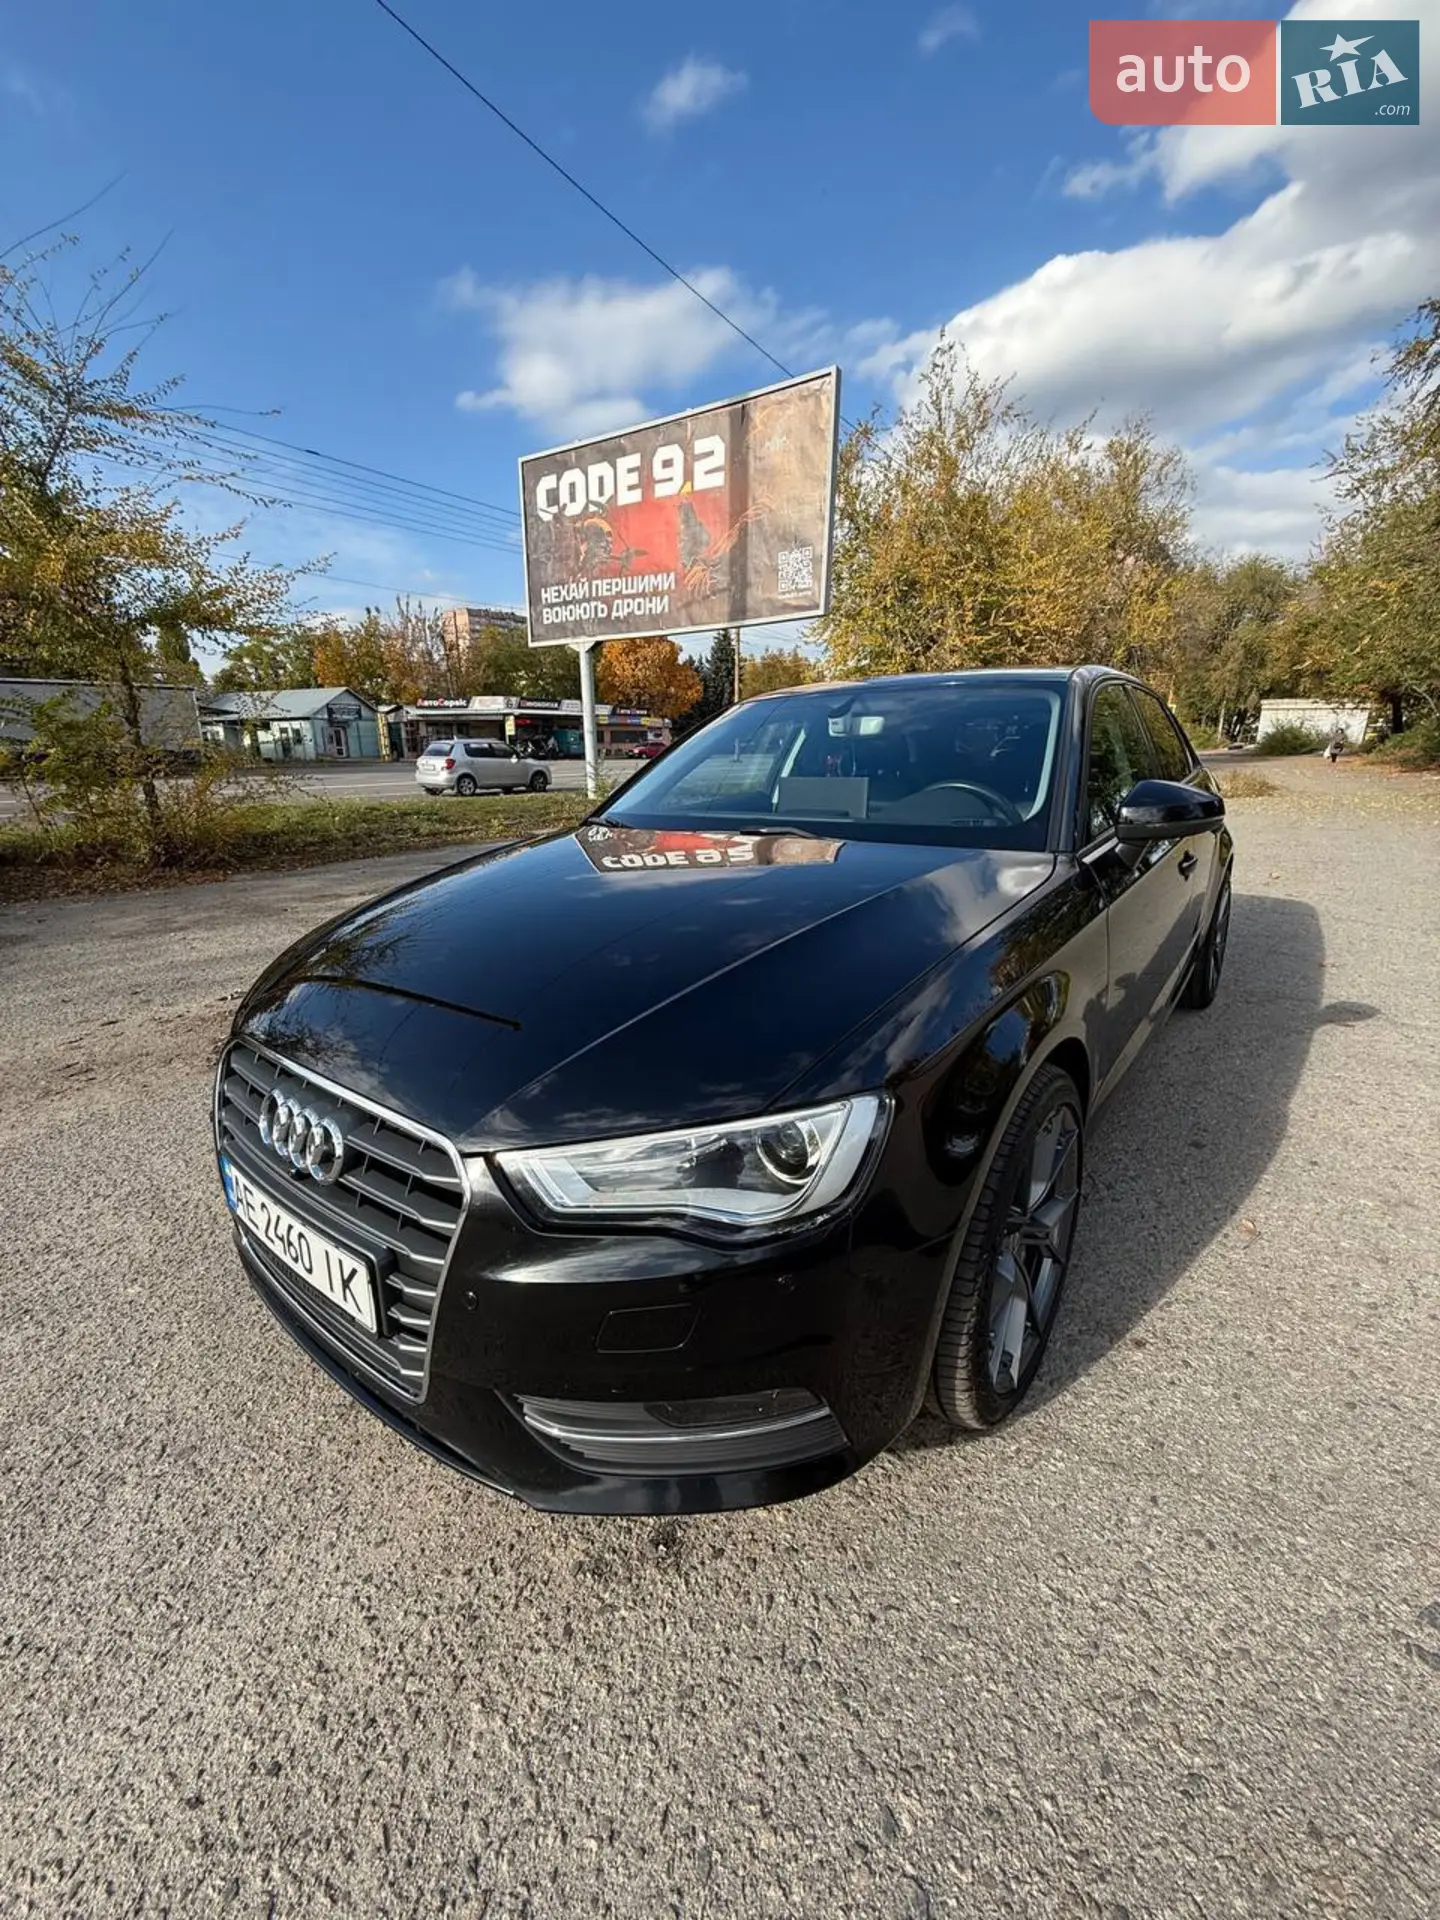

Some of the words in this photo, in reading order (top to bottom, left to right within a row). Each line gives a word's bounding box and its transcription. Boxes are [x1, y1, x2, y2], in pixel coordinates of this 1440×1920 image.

[536, 453, 642, 521] CODE
[541, 577, 589, 605] НЕХАЙ
[592, 572, 675, 597] ПЕРШИМИ
[611, 595, 669, 620] ДРОНИ
[234, 1174, 259, 1230] AE
[261, 1201, 314, 1275] 2460
[324, 1249, 363, 1314] IK
